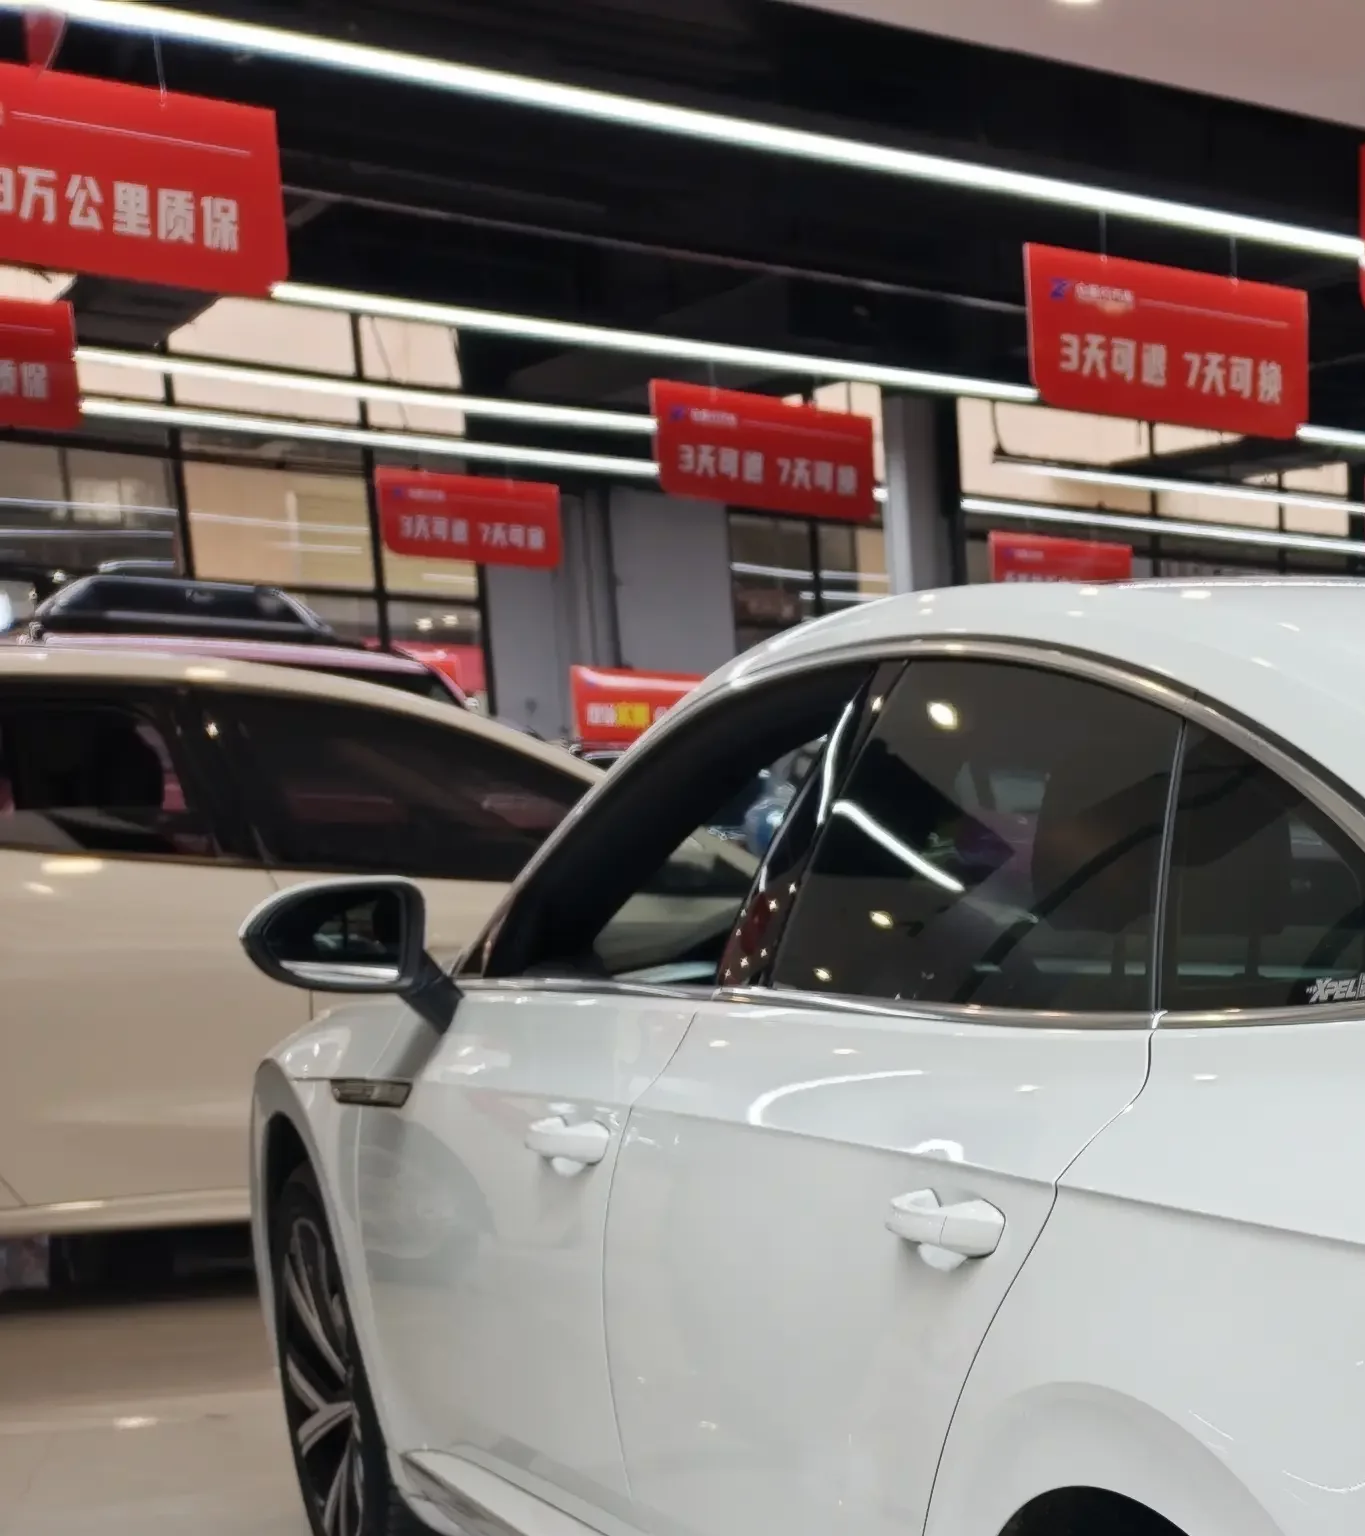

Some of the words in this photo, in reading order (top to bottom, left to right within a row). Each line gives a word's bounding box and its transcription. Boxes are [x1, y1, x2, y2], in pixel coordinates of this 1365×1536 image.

[1058, 333, 1167, 388] 3天可退
[1182, 351, 1283, 404] 7天可换
[1309, 977, 1357, 1004] XPEL
